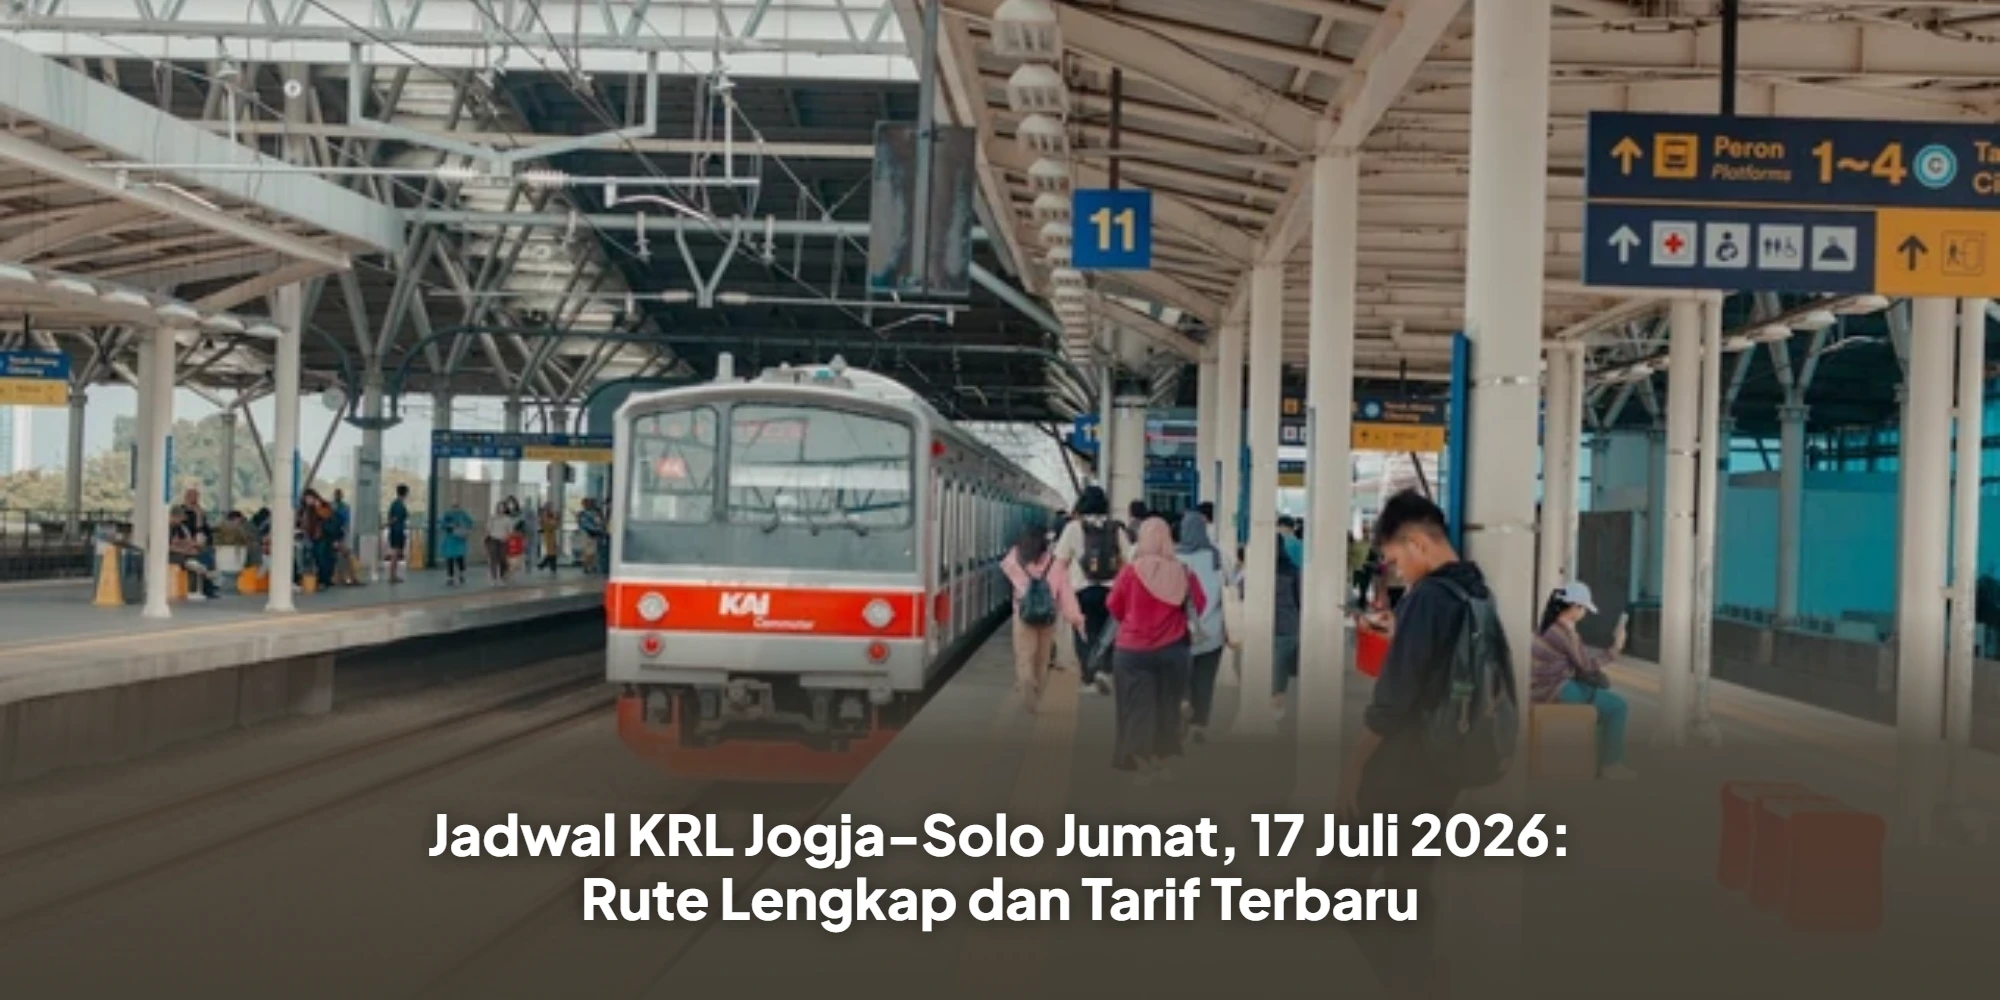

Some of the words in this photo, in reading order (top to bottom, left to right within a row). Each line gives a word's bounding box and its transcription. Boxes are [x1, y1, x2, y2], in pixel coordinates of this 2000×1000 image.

[1714, 135, 1785, 159] Peron
[1712, 164, 1792, 183] Platforms
[1812, 140, 1907, 186] 1~4
[1089, 207, 1135, 251] 11
[719, 591, 770, 616] KAI
